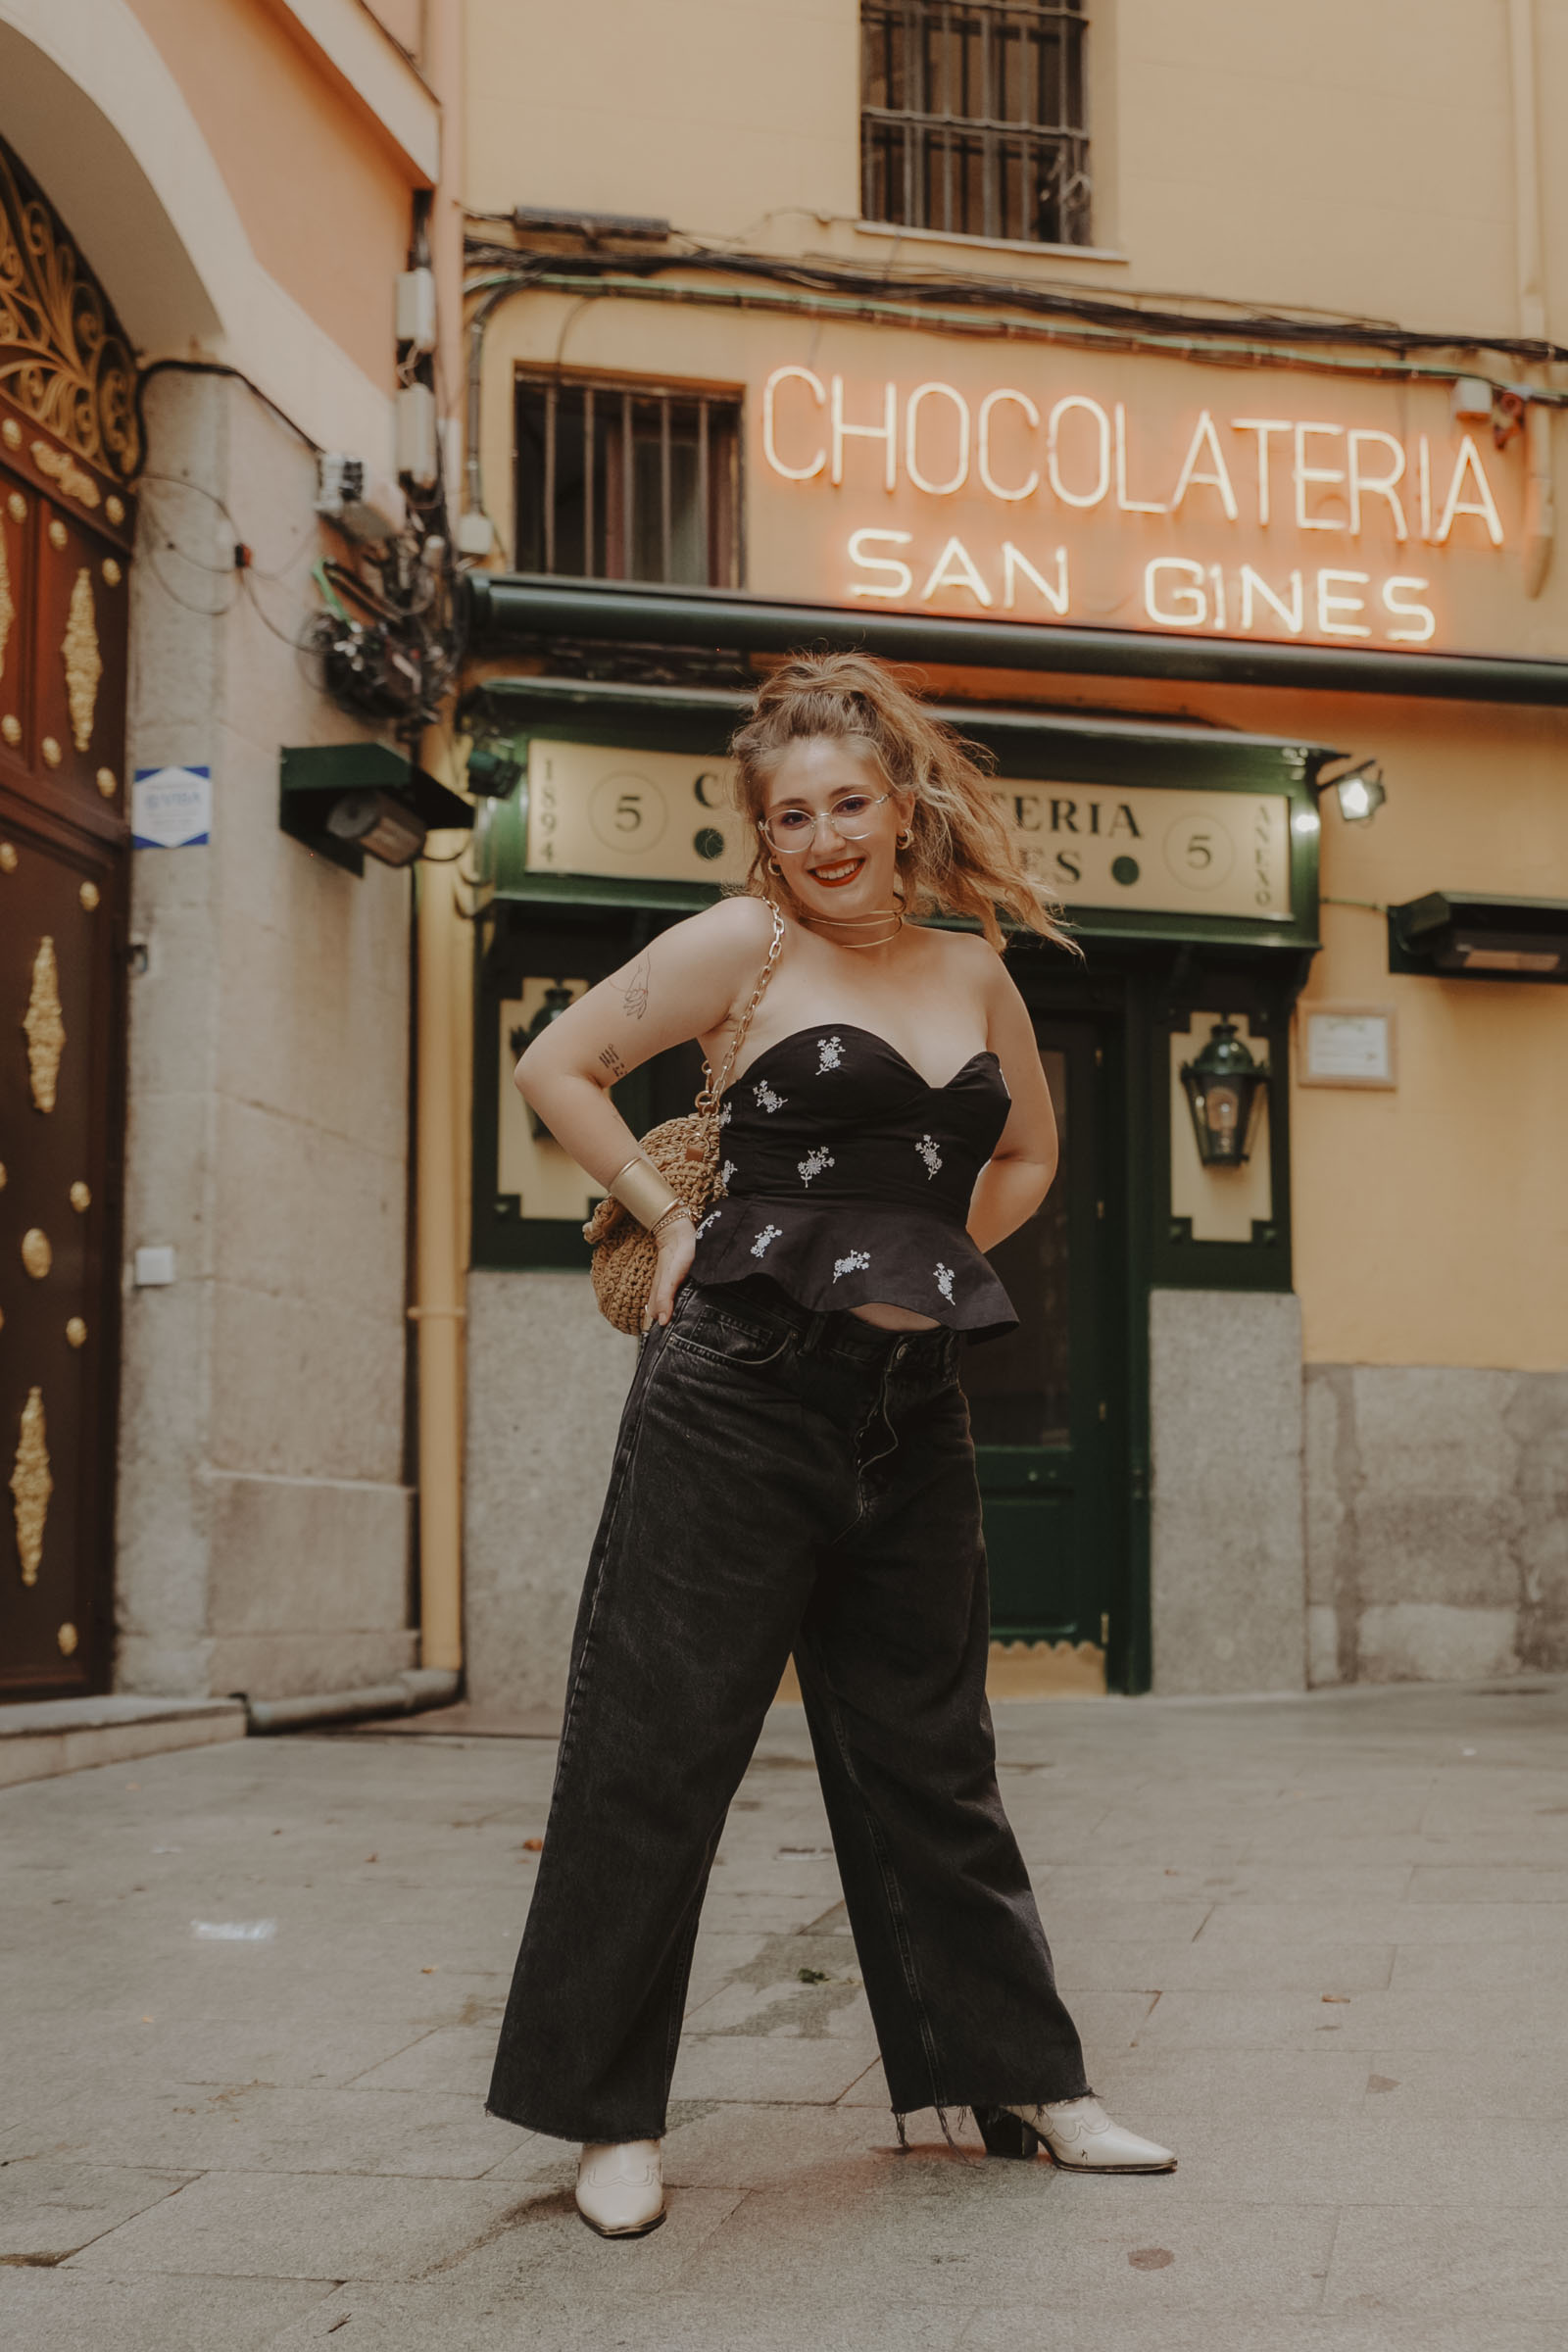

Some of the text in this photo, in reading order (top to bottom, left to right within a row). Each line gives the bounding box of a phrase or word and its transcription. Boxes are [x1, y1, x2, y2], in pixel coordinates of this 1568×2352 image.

[761, 365, 1505, 546] CHOCOLATERIA
[846, 527, 1437, 643] SAN GINES
[541, 759, 557, 863] 1894
[614, 795, 642, 832] 5
[1186, 835, 1212, 870] 5
